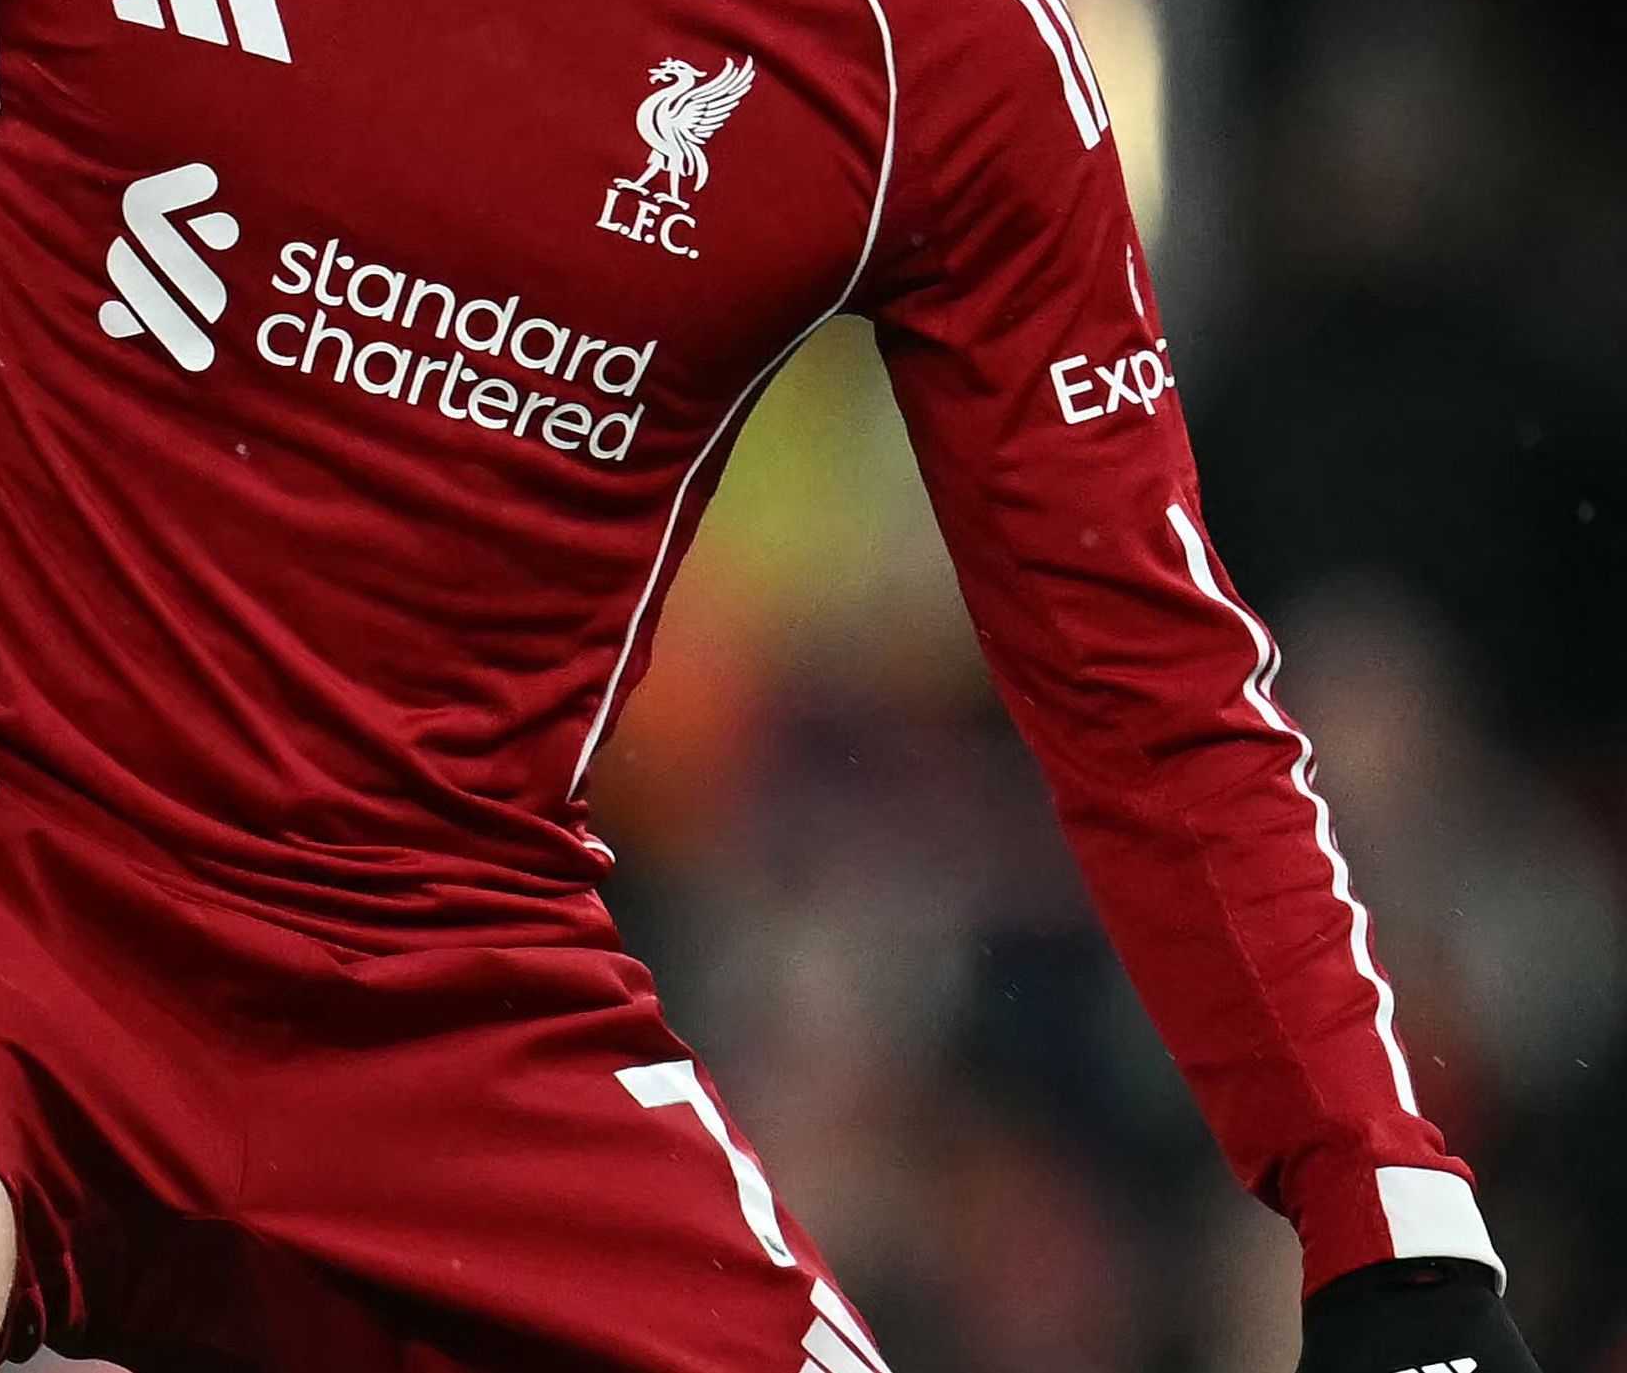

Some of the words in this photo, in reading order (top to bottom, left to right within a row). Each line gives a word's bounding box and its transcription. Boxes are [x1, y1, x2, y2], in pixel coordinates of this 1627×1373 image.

[595, 188, 699, 259] L.F.C.
[256, 308, 645, 461] chartered
[271, 238, 658, 397] standard
[1049, 337, 1176, 426] Exp
[613, 1059, 800, 1268] 7
